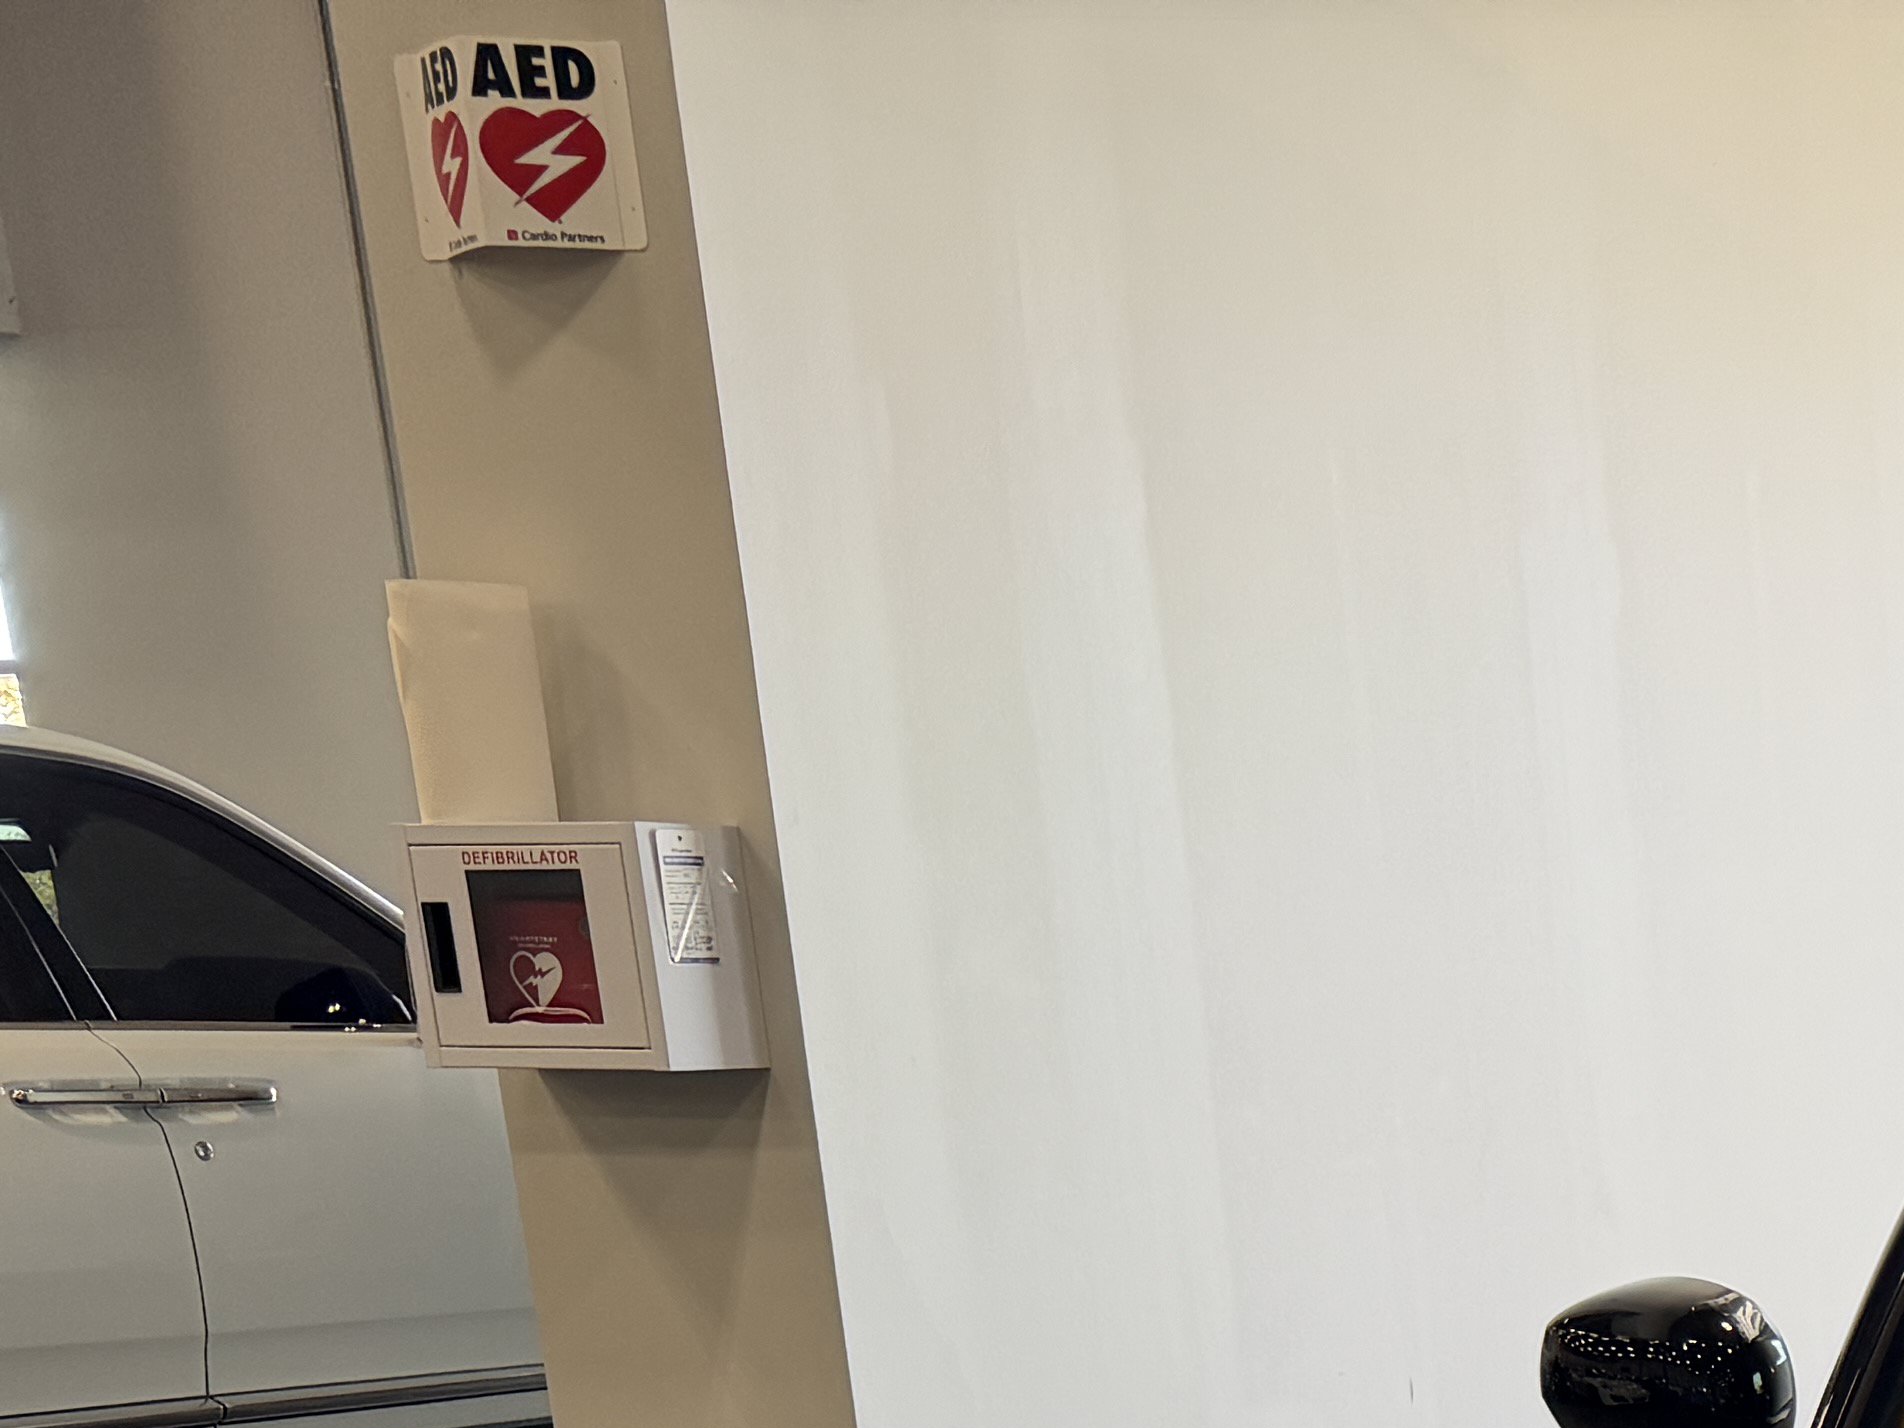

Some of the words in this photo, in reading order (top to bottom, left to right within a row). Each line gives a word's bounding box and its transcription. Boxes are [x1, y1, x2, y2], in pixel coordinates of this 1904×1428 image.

[420, 46, 458, 113] AED
[472, 42, 595, 100] AED
[522, 229, 557, 242] Cardio
[561, 230, 605, 243] Partners
[461, 850, 579, 865] DEFIBRILLATOR
